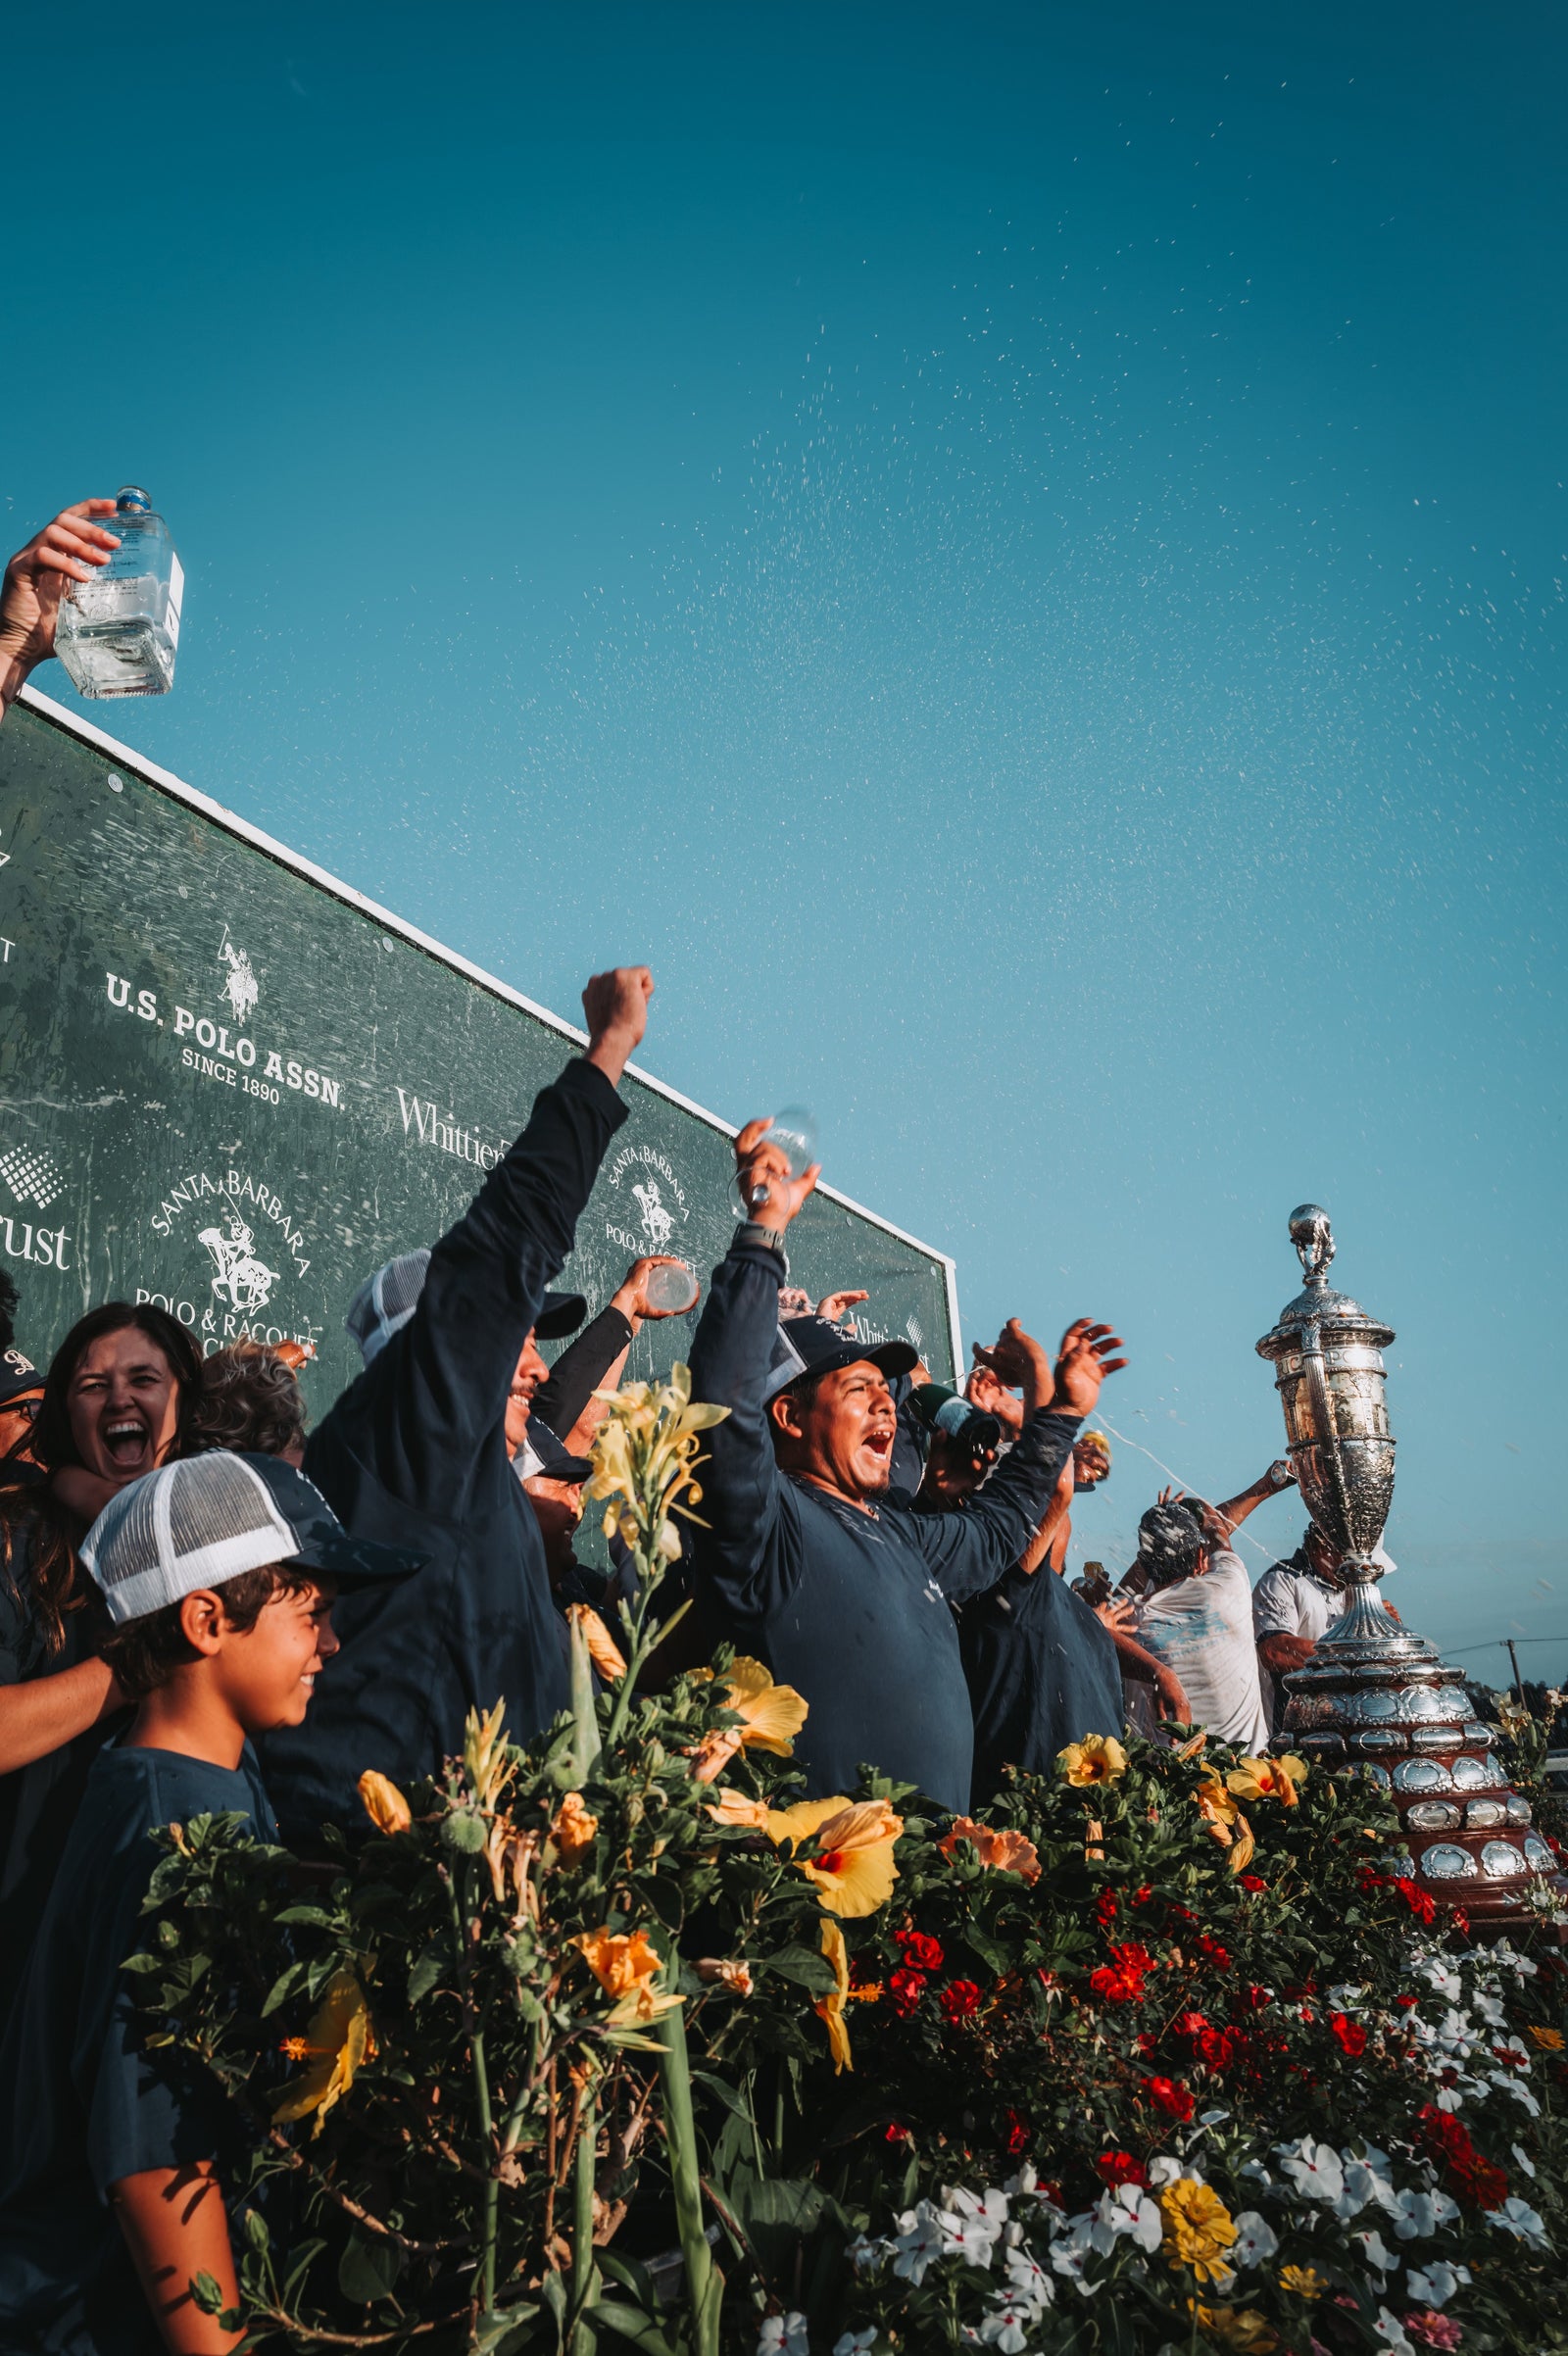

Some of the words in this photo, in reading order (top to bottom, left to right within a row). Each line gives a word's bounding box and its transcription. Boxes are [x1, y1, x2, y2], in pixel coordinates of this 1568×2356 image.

[106, 971, 164, 1026] U.S.
[173, 1006, 256, 1066] POLO
[264, 1051, 345, 1110] ASSN.
[181, 1049, 237, 1087] SINCE
[242, 1076, 279, 1105] 1890
[610, 1147, 639, 1190] SANTA
[644, 1146, 690, 1222] BARBARA
[0, 1215, 72, 1270] ust
[151, 1172, 216, 1237] SANTA
[228, 1170, 312, 1279] BARBARA
[606, 1223, 636, 1251] POLO
[201, 1308, 217, 1333] &
